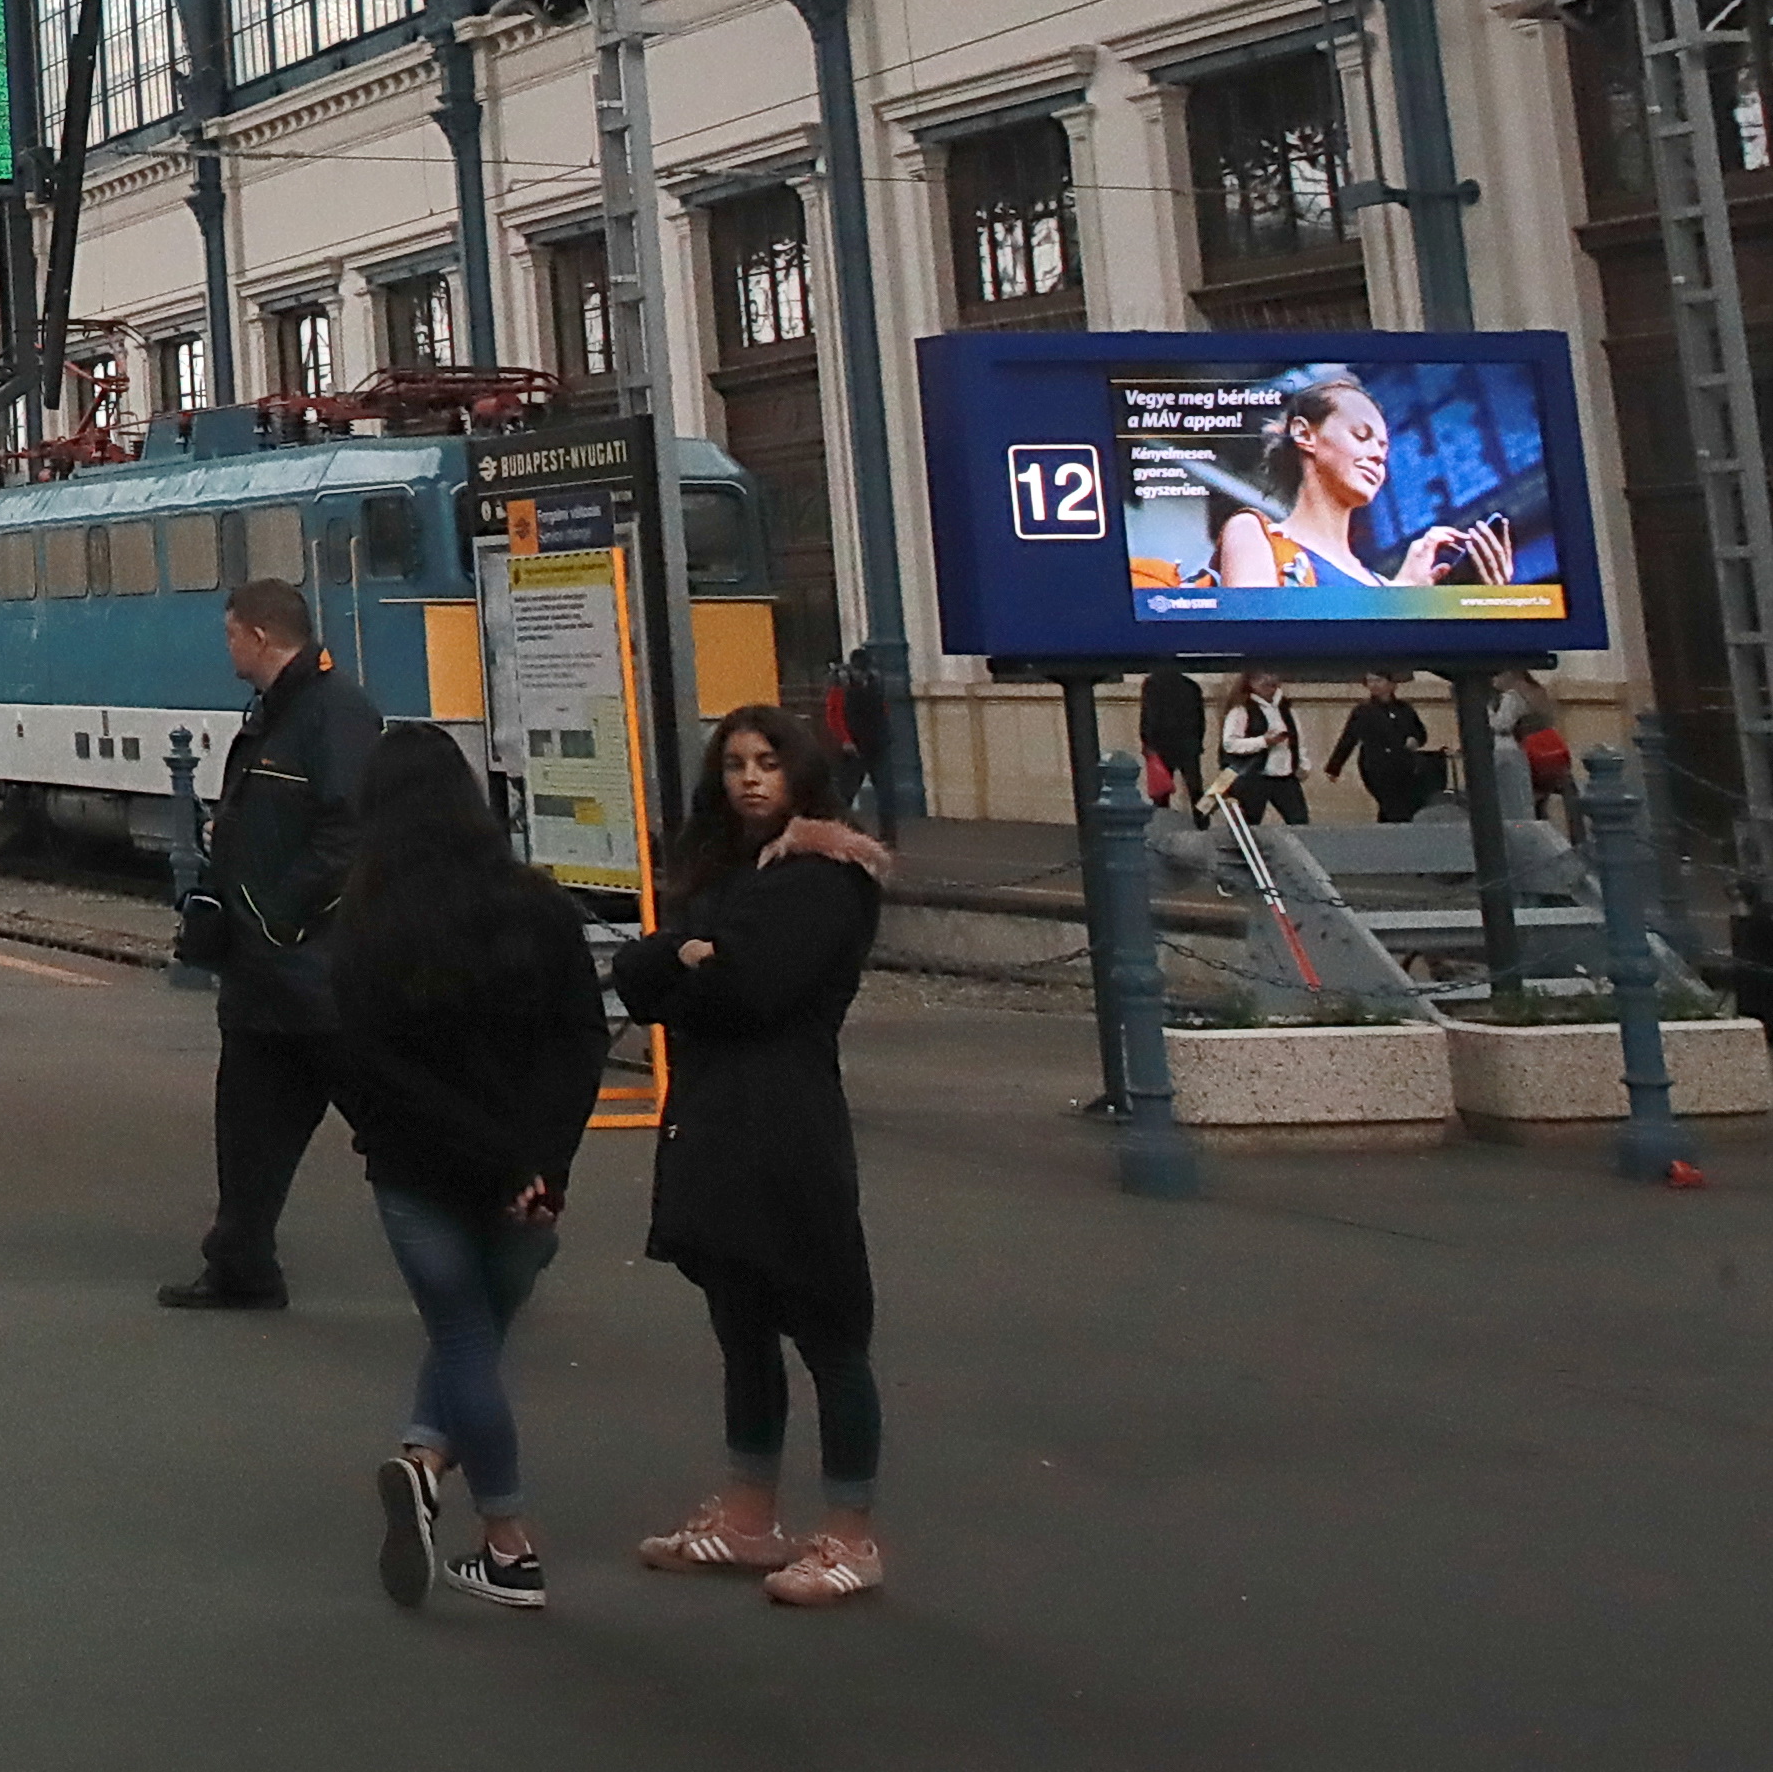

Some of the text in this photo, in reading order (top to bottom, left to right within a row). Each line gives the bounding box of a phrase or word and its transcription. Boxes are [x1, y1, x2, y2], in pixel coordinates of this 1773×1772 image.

[1125, 388, 1282, 409] Vegye meg bérletét
[1128, 409, 1242, 431] a MÁV appon!
[501, 440, 627, 478] BUDAPEST-NYUGATI
[1019, 462, 1096, 521] 12
